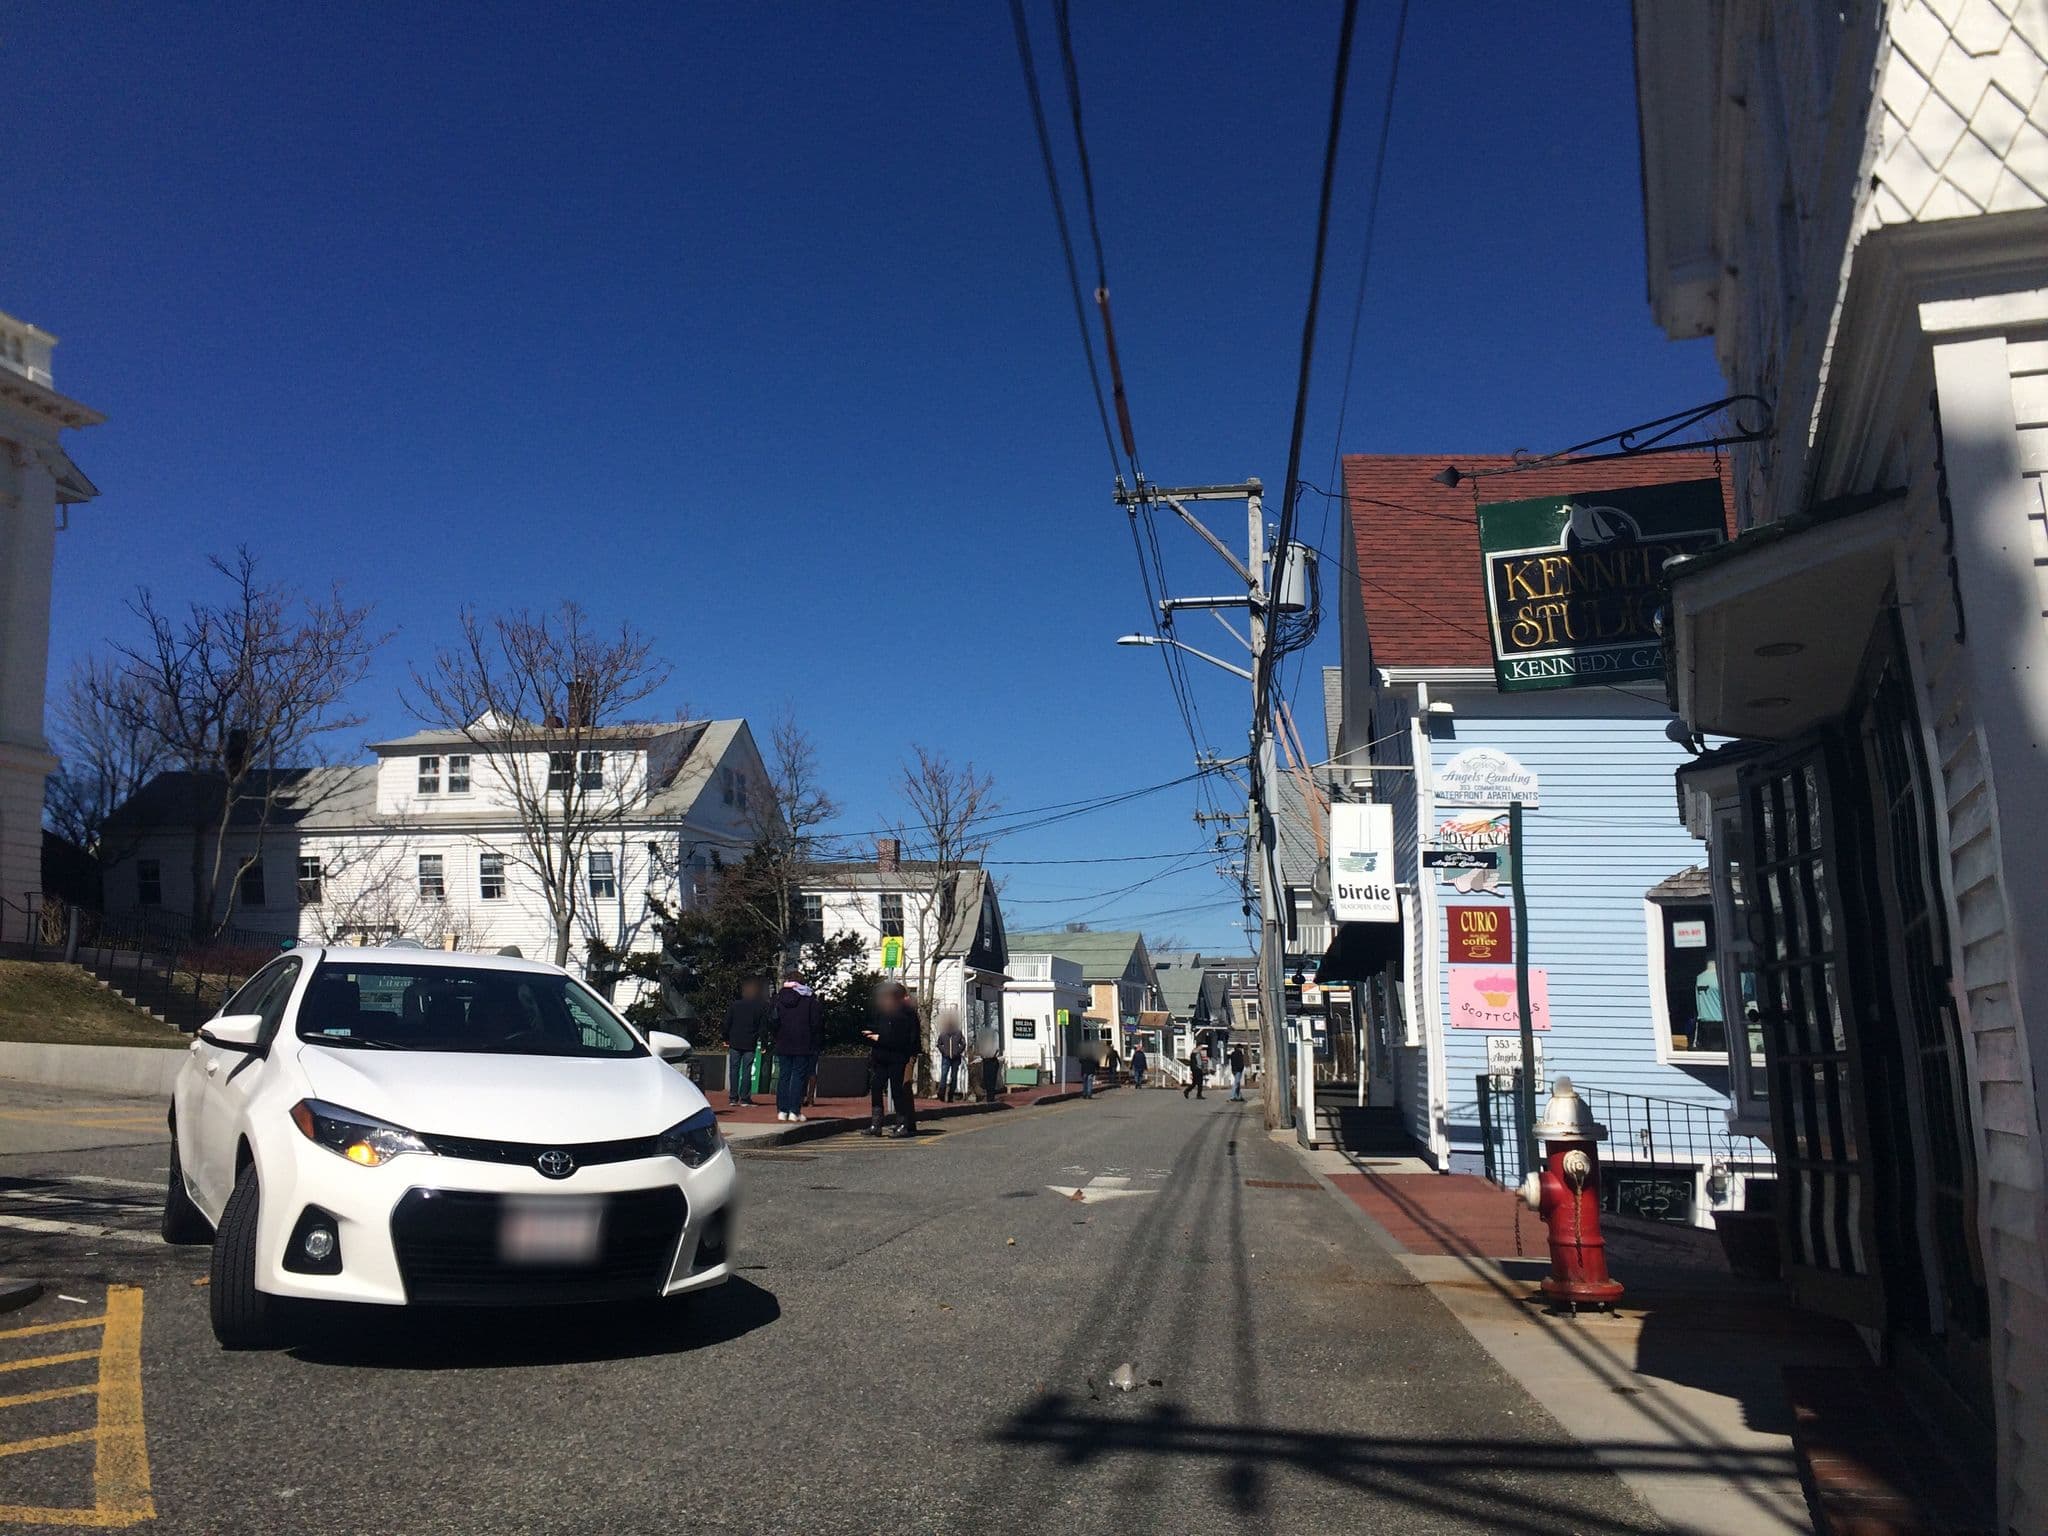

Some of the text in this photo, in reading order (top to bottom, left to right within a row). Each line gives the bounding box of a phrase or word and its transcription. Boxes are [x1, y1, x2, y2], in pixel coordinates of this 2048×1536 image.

[1512, 653, 1624, 678] KENNEDY
[1434, 790, 1539, 801] WATERFRONT APARTMENTS
[1337, 883, 1391, 901] birdie
[1460, 911, 1498, 932] CURIO
[1462, 936, 1498, 946] coffee
[1461, 1001, 1541, 1022] SCOTTCAS
[1494, 1039, 1510, 1049] 353
